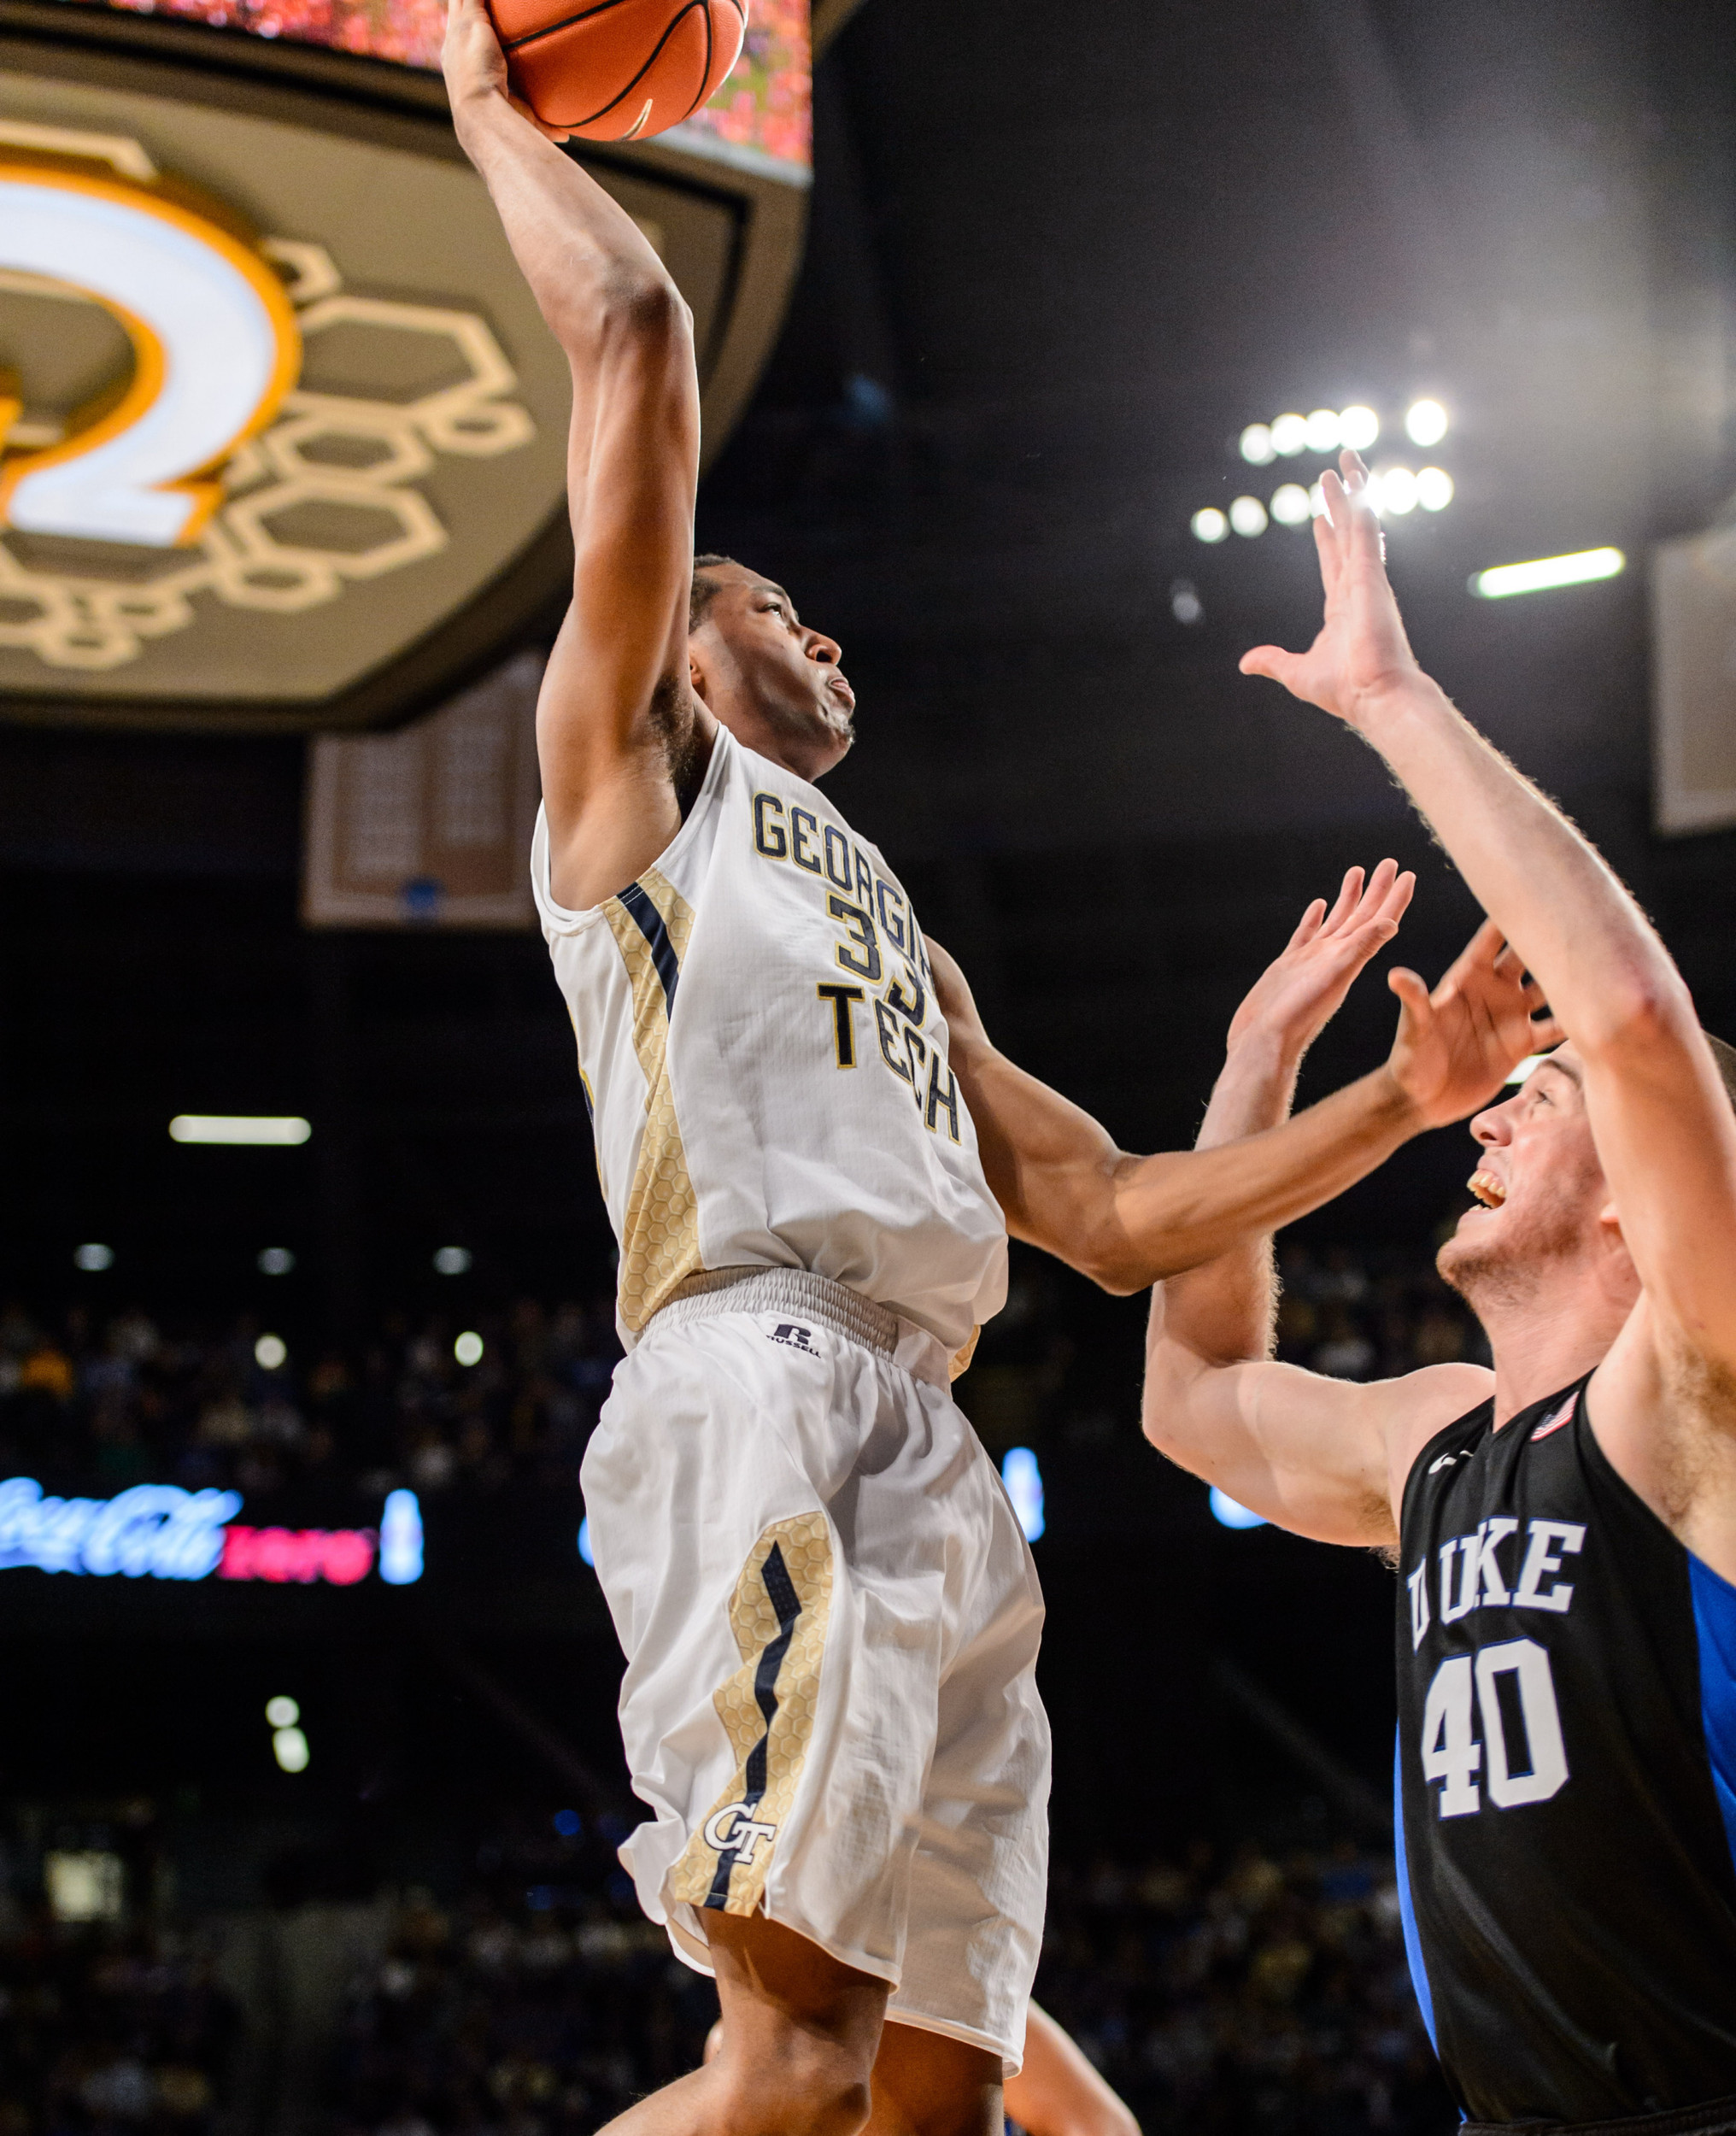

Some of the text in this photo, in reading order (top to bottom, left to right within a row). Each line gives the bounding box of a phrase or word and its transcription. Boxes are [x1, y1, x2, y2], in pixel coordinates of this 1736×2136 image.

[817, 982, 962, 1146] TECH
[1407, 1515, 1586, 1655] DUKE
[1421, 1636, 1570, 1820] 40
[703, 1802, 777, 1865] GT
